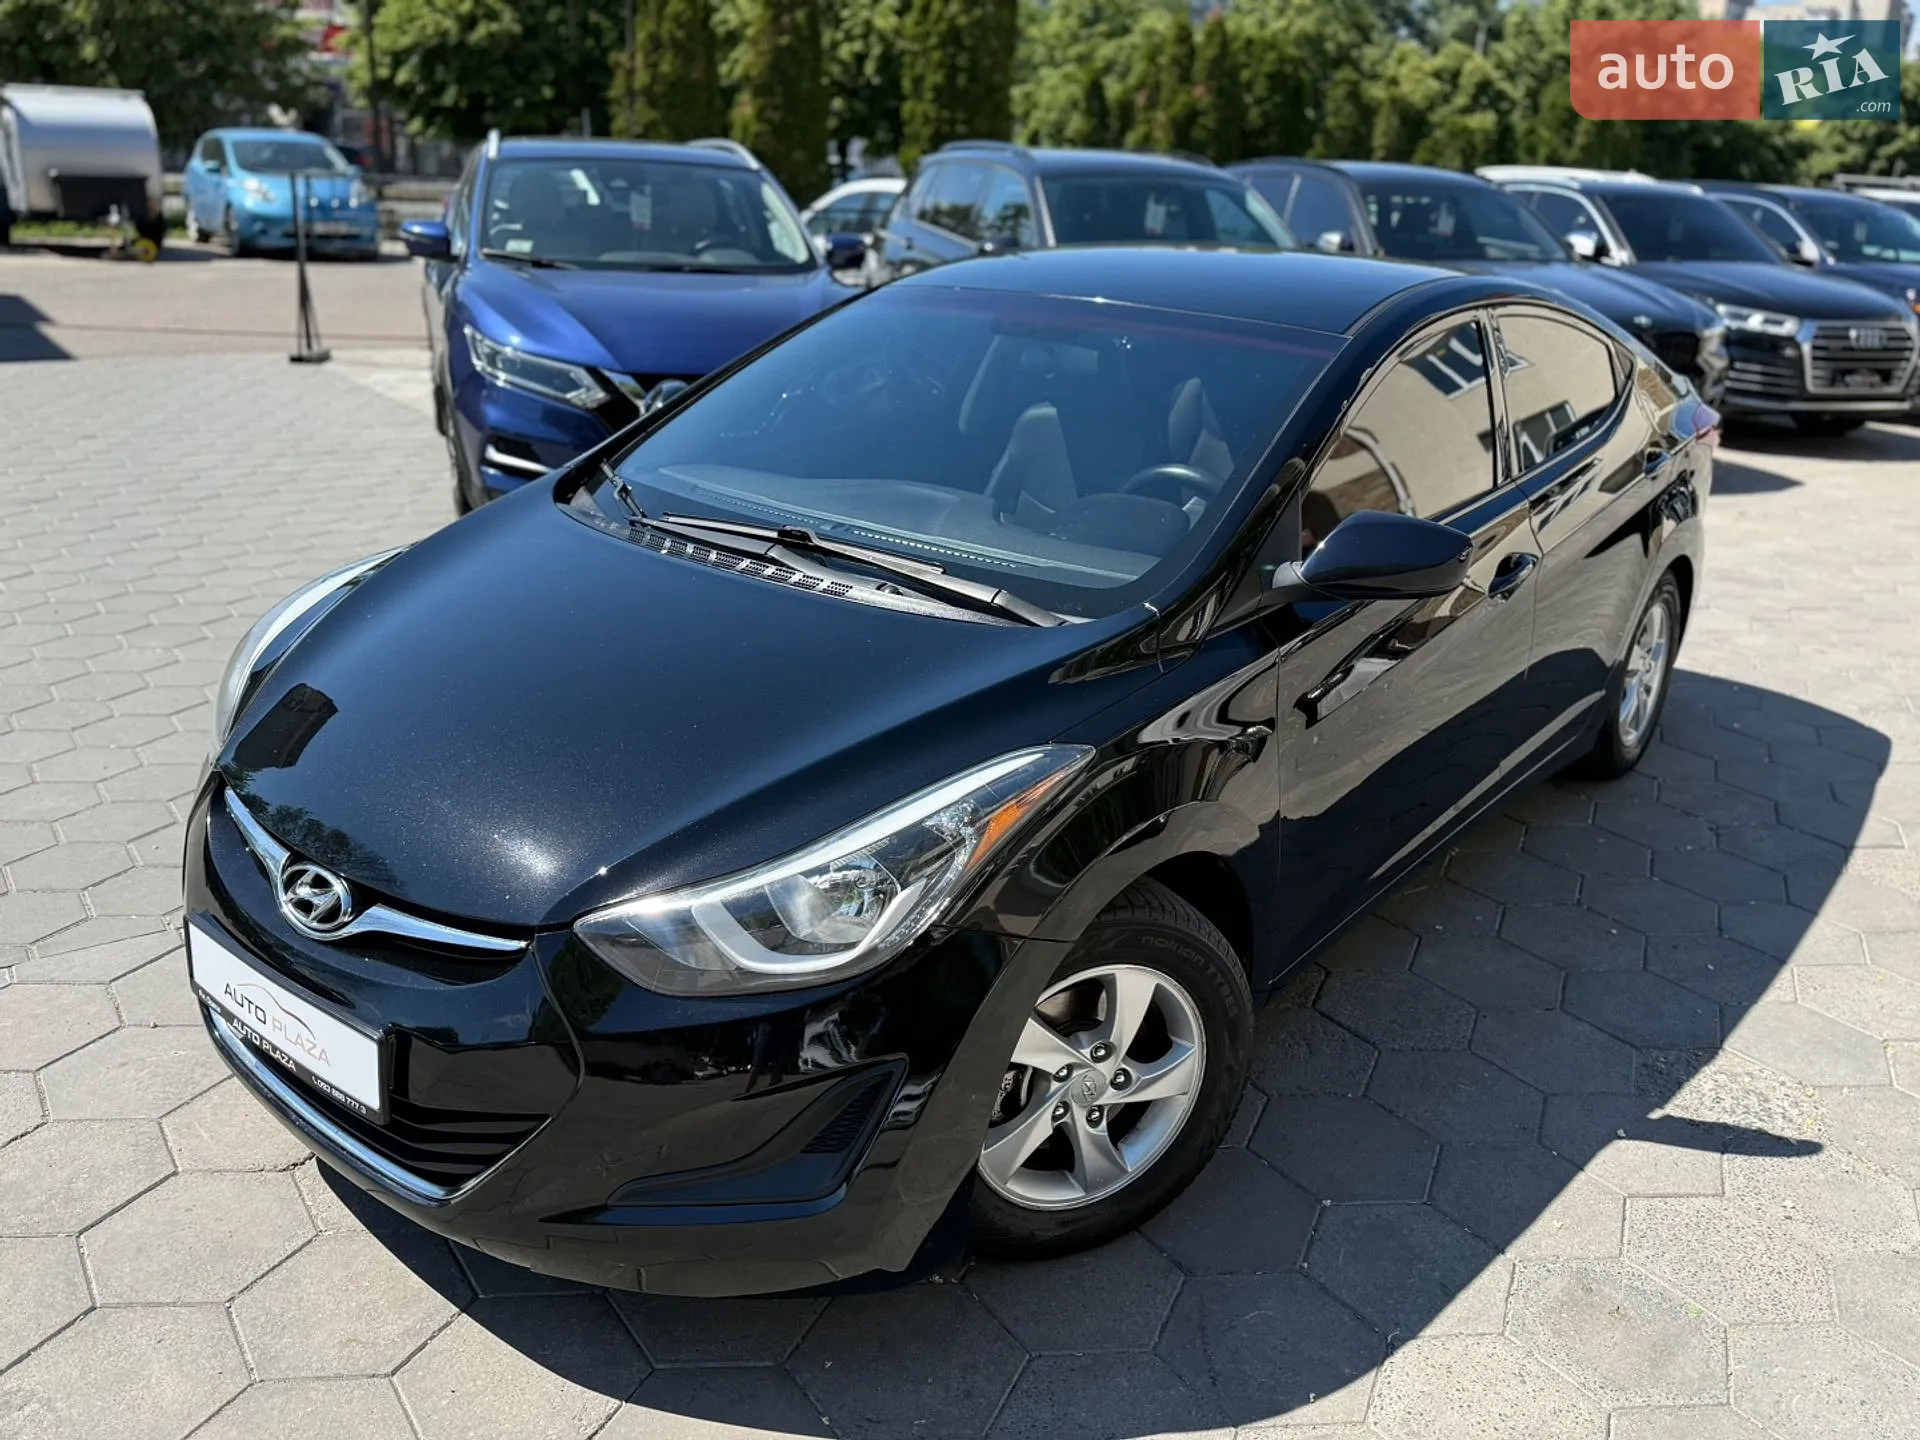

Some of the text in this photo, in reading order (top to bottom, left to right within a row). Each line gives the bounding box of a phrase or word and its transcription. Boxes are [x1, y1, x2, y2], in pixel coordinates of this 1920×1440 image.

[224, 983, 266, 1025] AUTO
[272, 1016, 331, 1067] PLAZA
[232, 1018, 297, 1072] AUTO PLAZA
